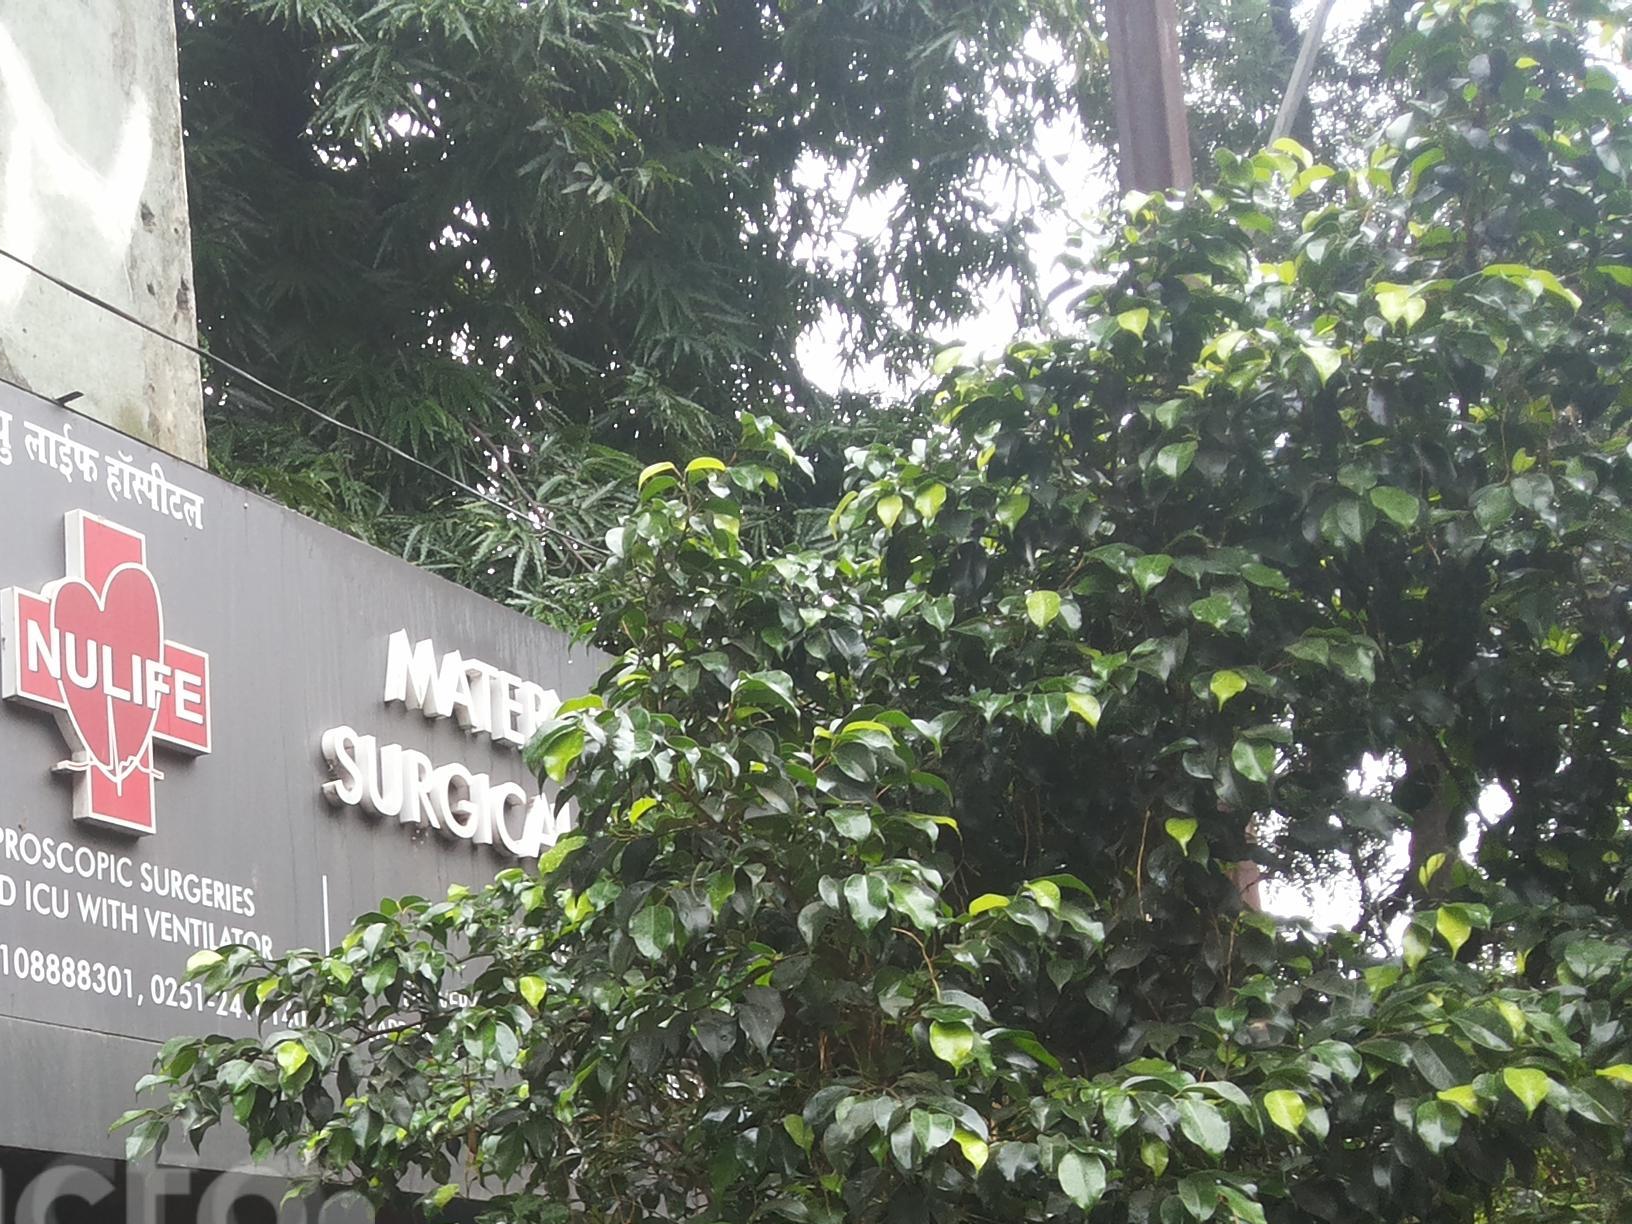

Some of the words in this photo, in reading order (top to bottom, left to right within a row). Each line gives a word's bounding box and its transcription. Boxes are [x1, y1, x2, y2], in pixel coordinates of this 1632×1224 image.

[23, 420, 99, 483] लाईफ
[104, 450, 204, 530] हॉस्पीटल
[26, 617, 205, 726] NULIFE
[384, 627, 562, 748] MATER
[24, 879, 70, 919] ICU
[77, 891, 139, 934] WITH
[143, 907, 274, 961] VENTILATOR
[140, 862, 256, 918] SURGERIES
